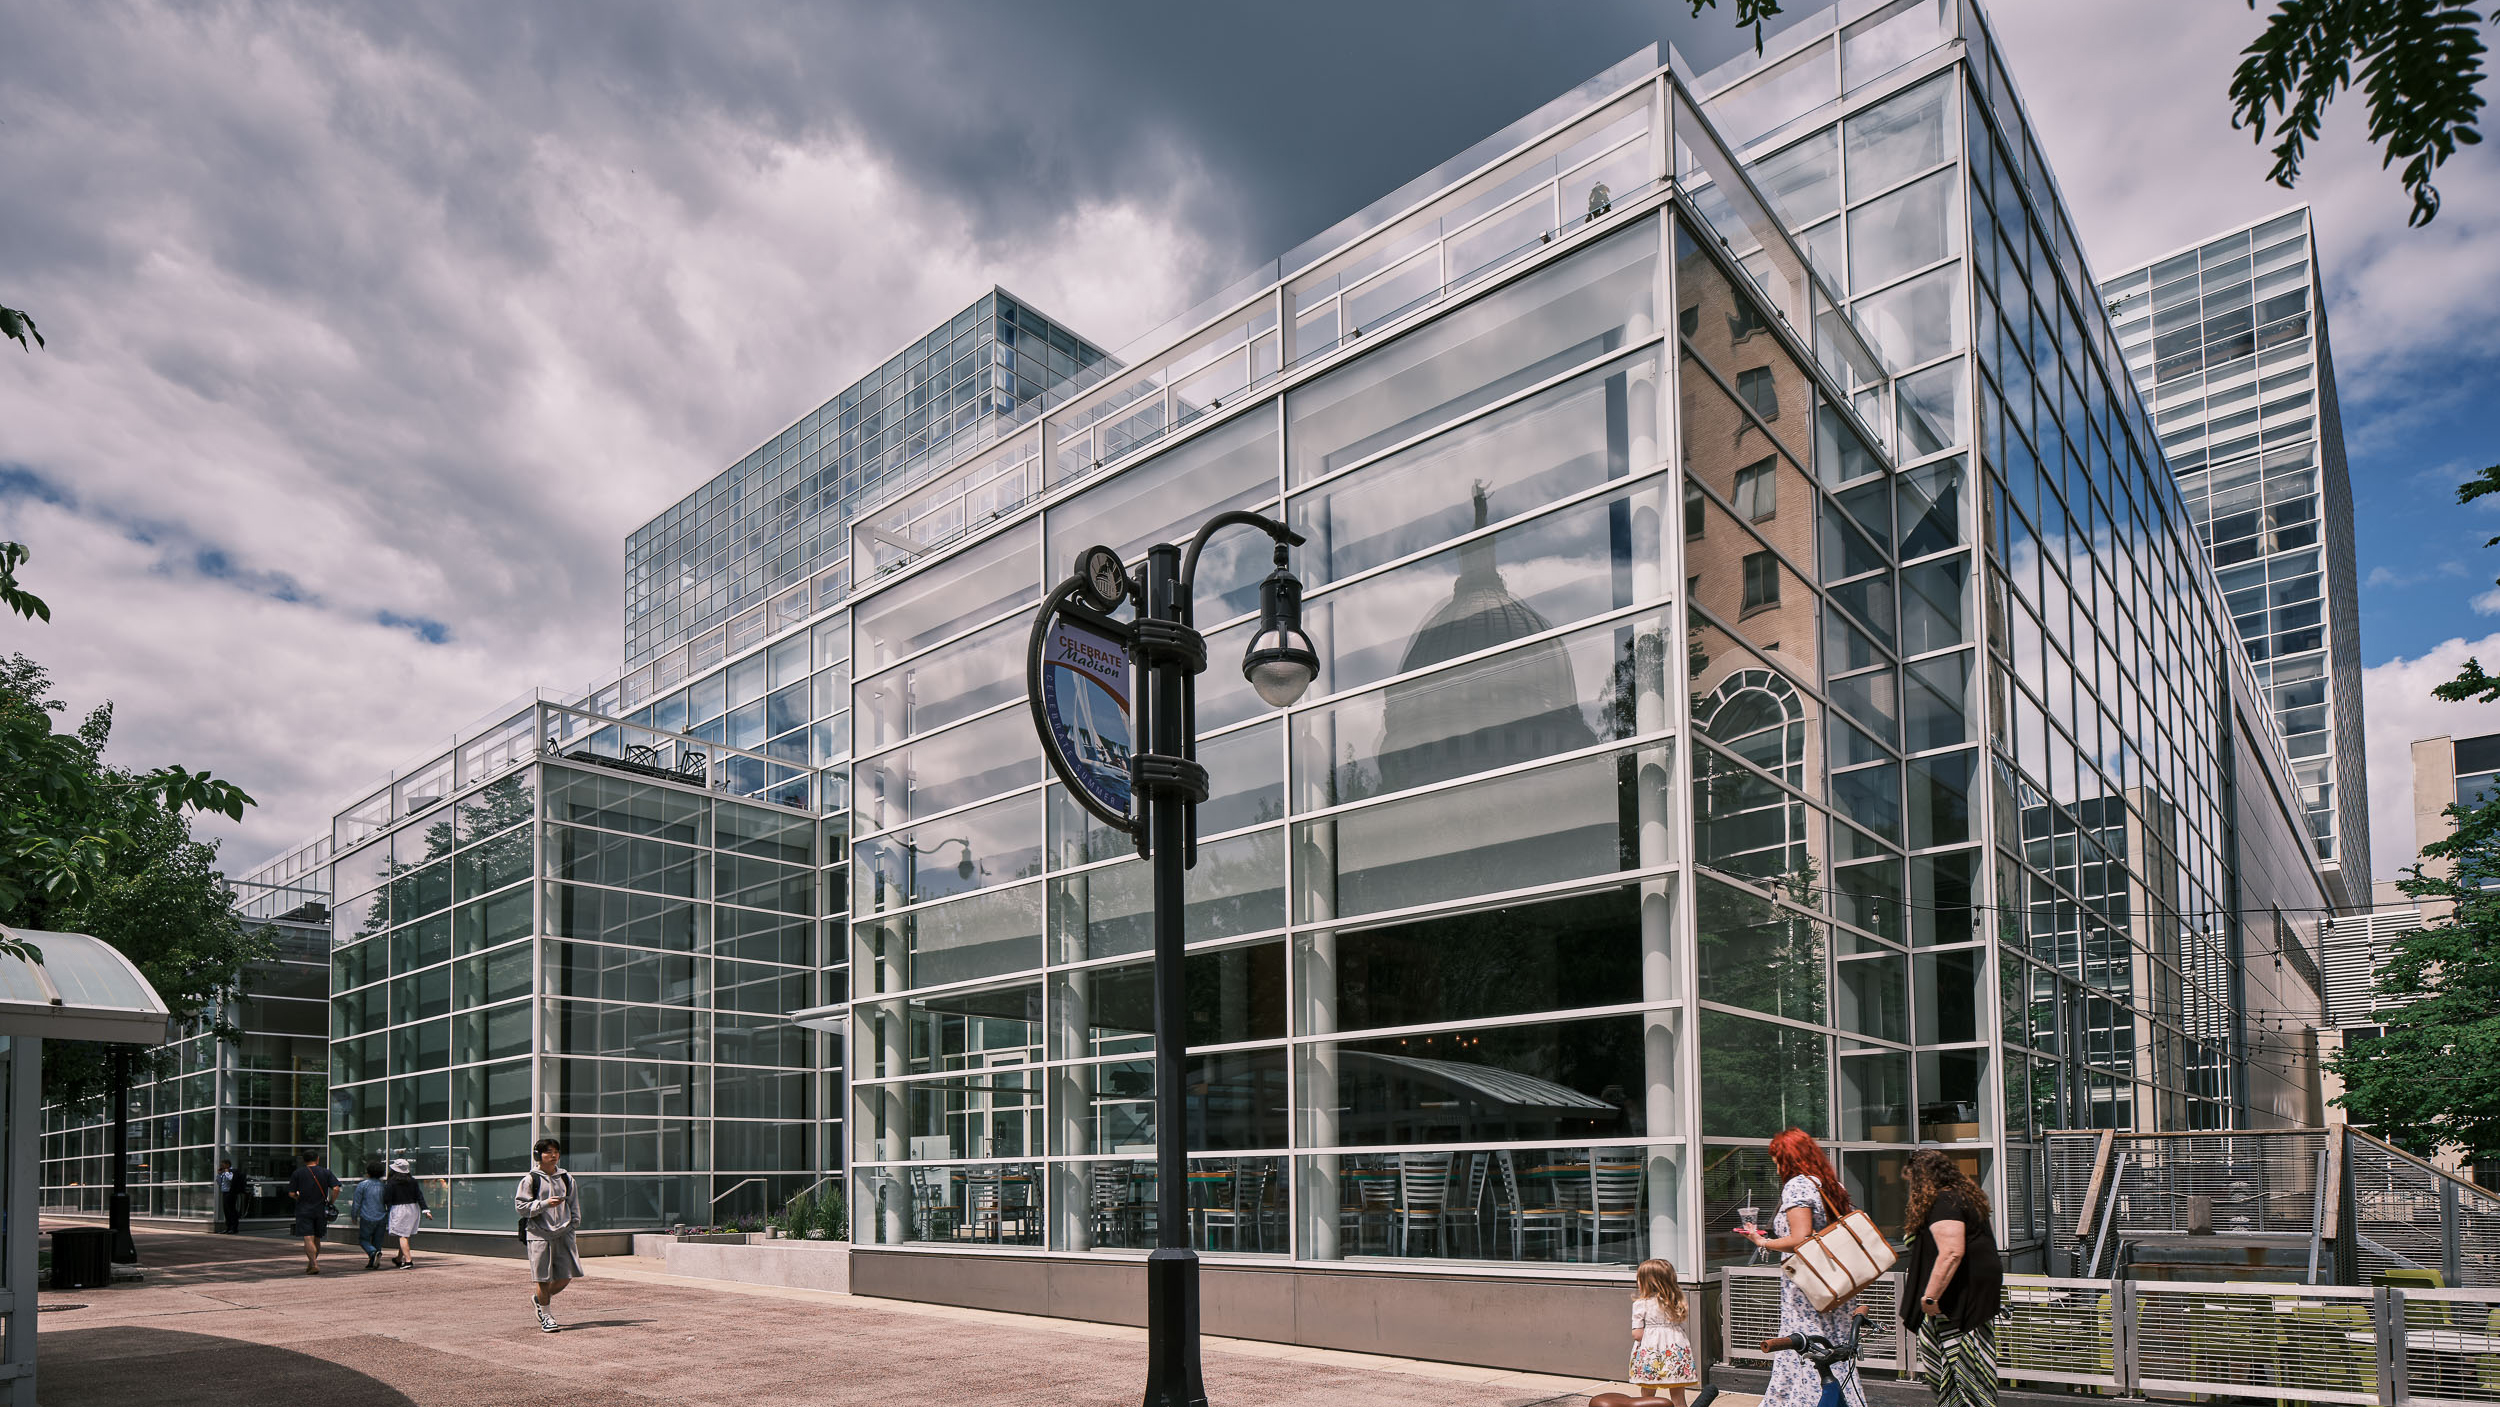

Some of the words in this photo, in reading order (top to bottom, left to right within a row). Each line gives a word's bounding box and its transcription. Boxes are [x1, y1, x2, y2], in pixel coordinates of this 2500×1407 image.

[1058, 647, 1119, 678] Madison
[1059, 635, 1122, 669] CELEBRATE
[1046, 674, 1073, 757] CELEBRATE
[1075, 764, 1116, 805] SUMMER
